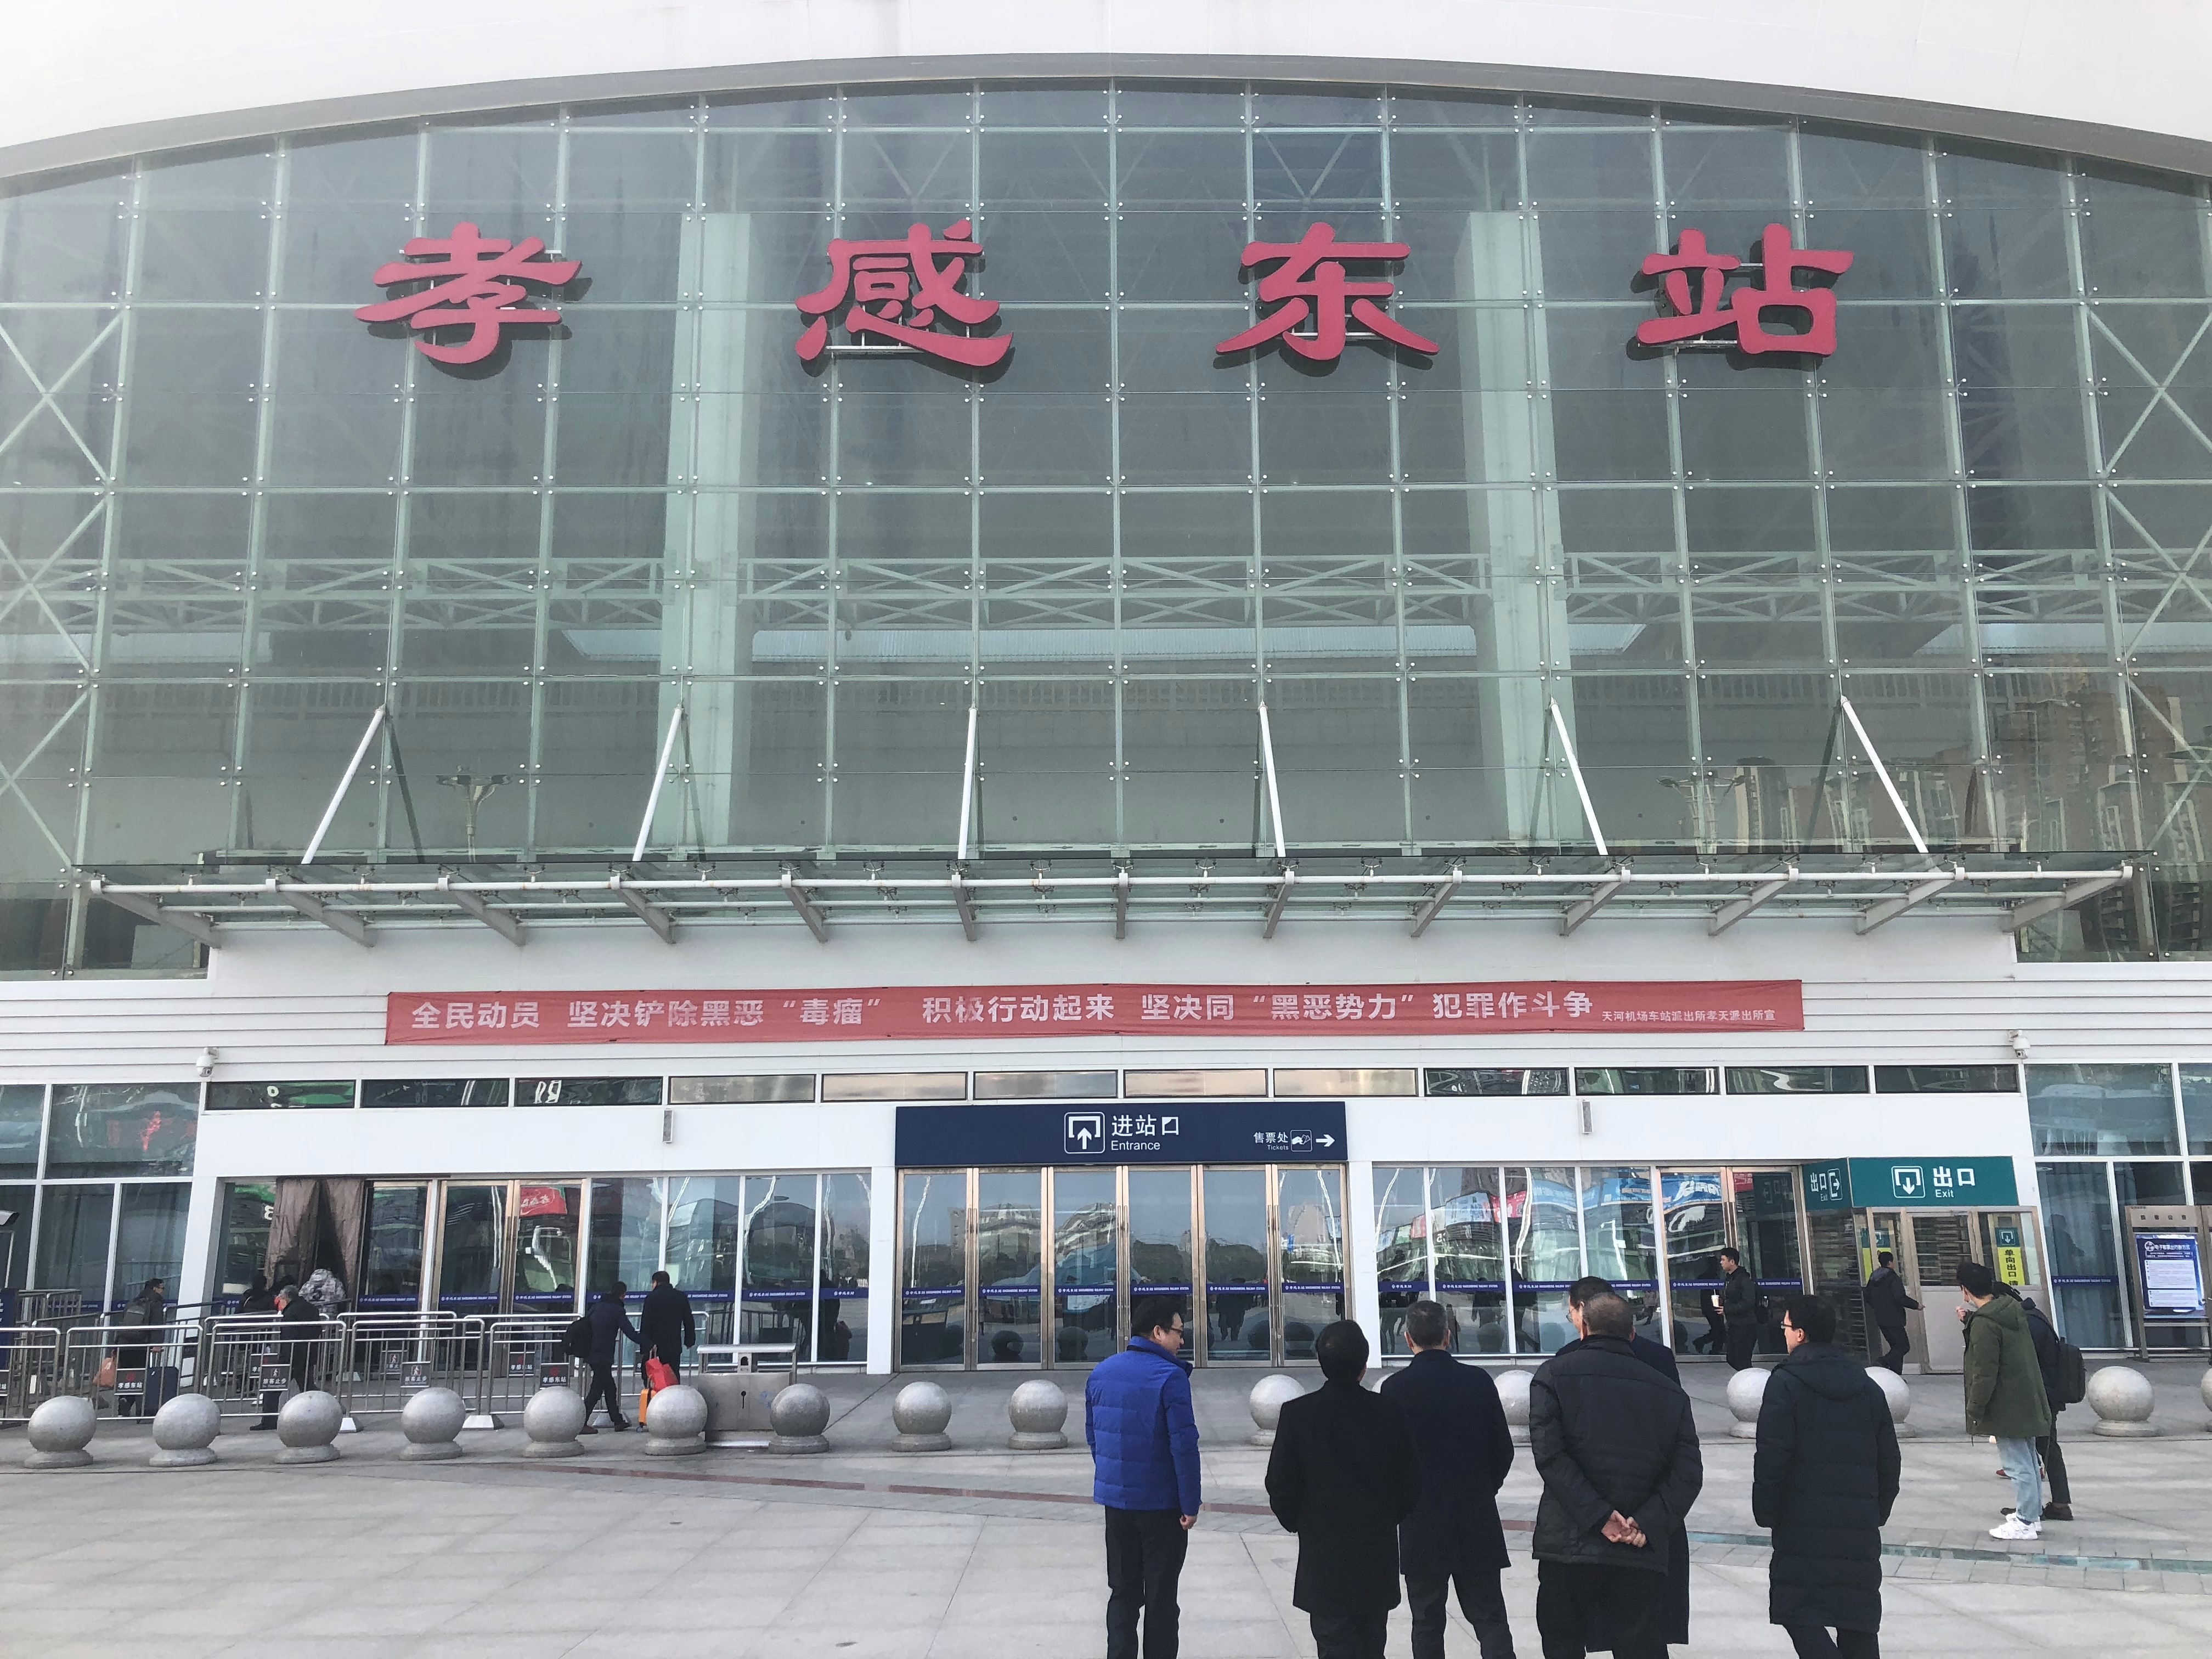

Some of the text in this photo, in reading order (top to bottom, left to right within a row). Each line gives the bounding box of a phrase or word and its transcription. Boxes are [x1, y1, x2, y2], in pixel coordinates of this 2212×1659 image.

[354, 221, 1854, 366] 孝感东站
[411, 1001, 540, 1029] 全民动员
[922, 994, 1115, 1023] 积极行动起来
[1111, 1114, 1179, 1136] 进站口
[1111, 1140, 1160, 1150] Entrance
[1253, 1132, 1288, 1143] 售票处
[1810, 1172, 1827, 1192] 出口
[1933, 1166, 1975, 1187] 出口
[1935, 1189, 1954, 1198] Exit
